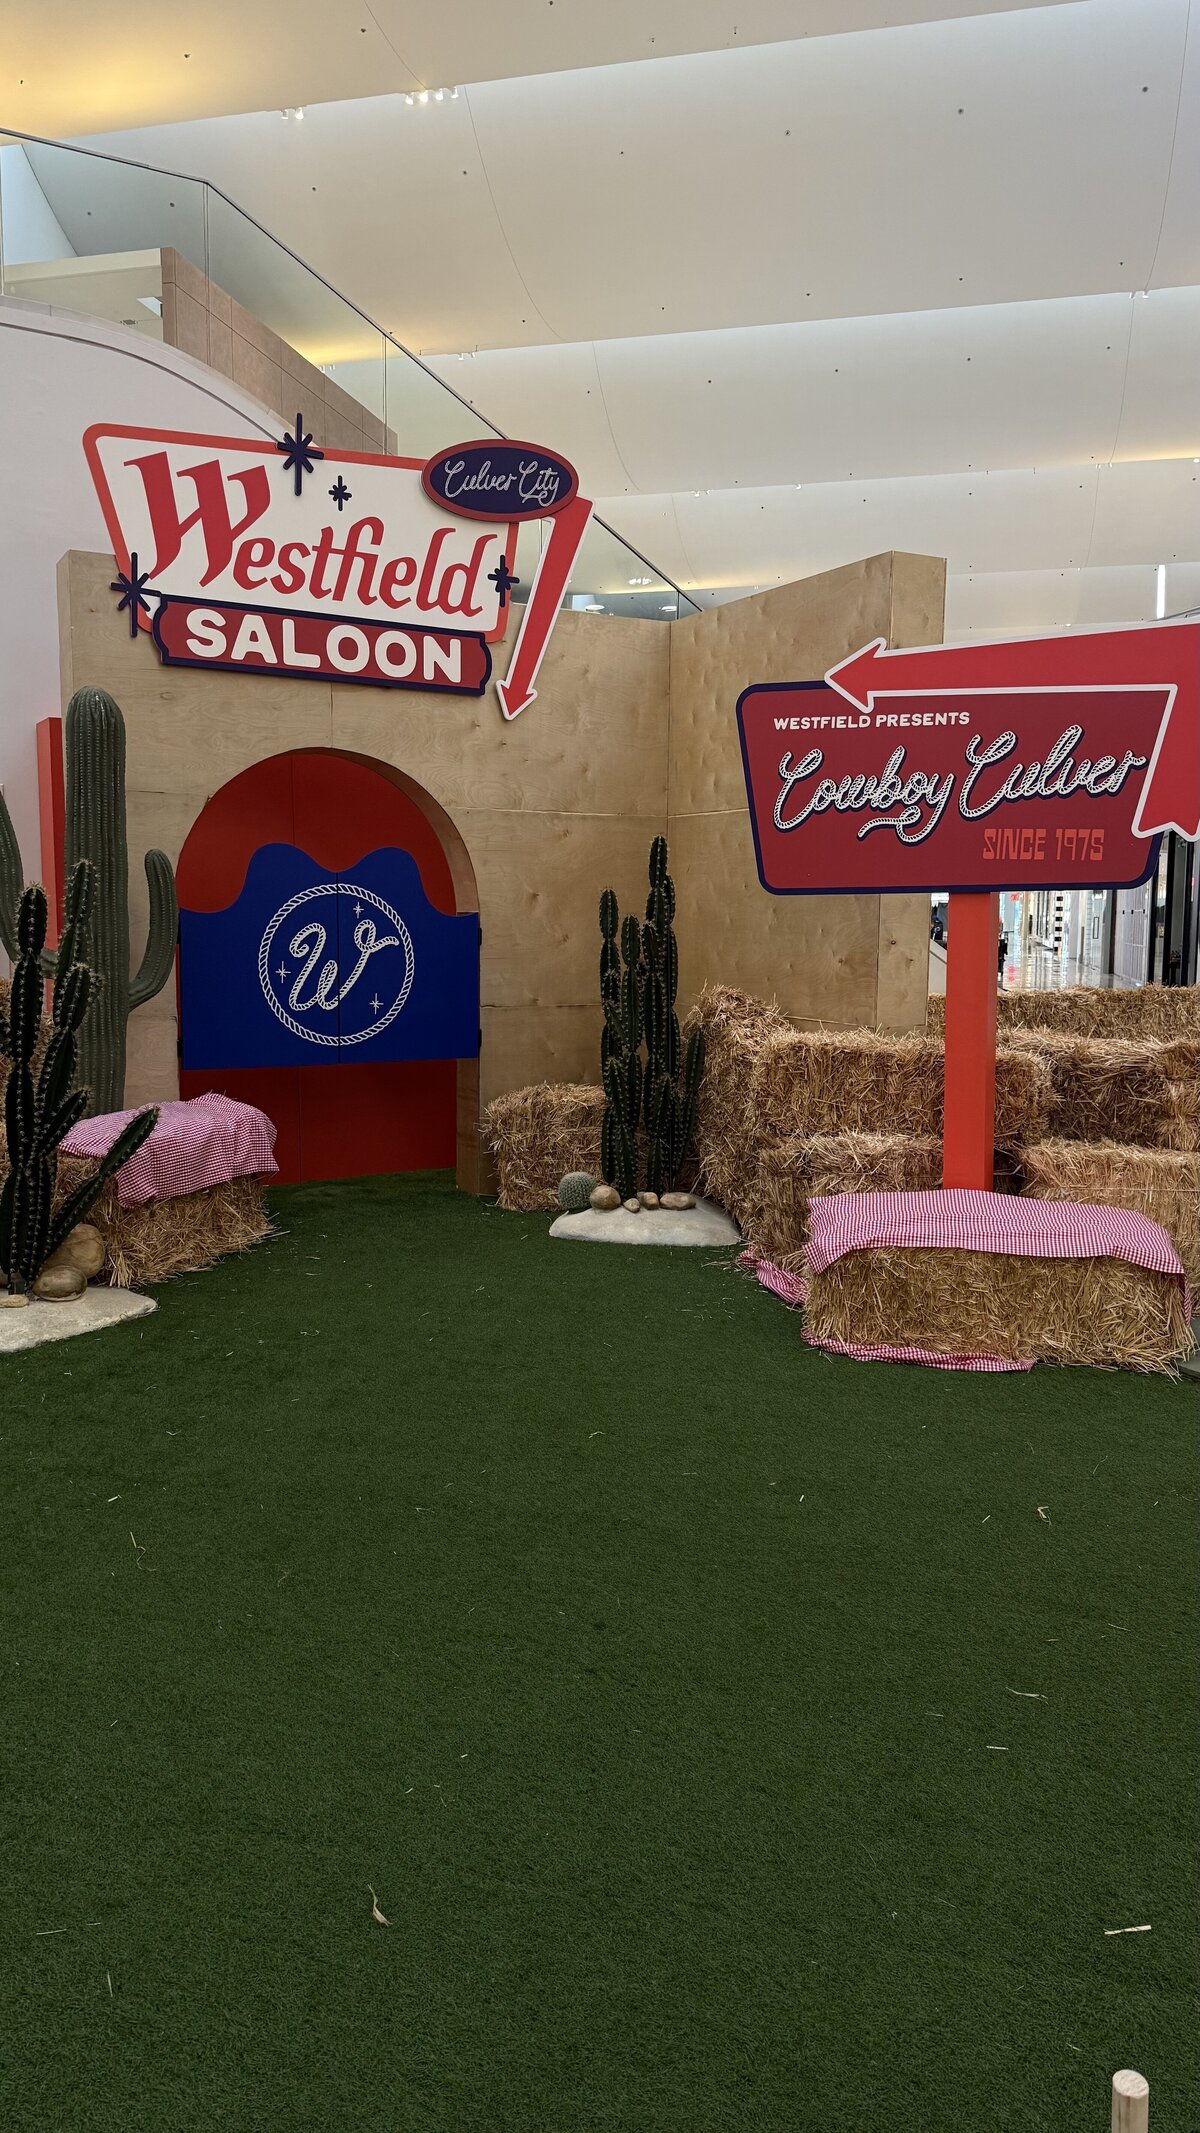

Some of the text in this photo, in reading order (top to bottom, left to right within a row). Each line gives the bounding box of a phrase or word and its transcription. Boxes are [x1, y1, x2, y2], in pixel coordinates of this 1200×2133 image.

[444, 460, 560, 507] Culver City
[123, 451, 499, 617] Westfield
[185, 608, 462, 684] SALOON
[773, 711, 970, 731] WESTFIELD PRESENTS
[773, 724, 1147, 843] Cowboy Culver
[982, 828, 1105, 861] SINCE 1975
